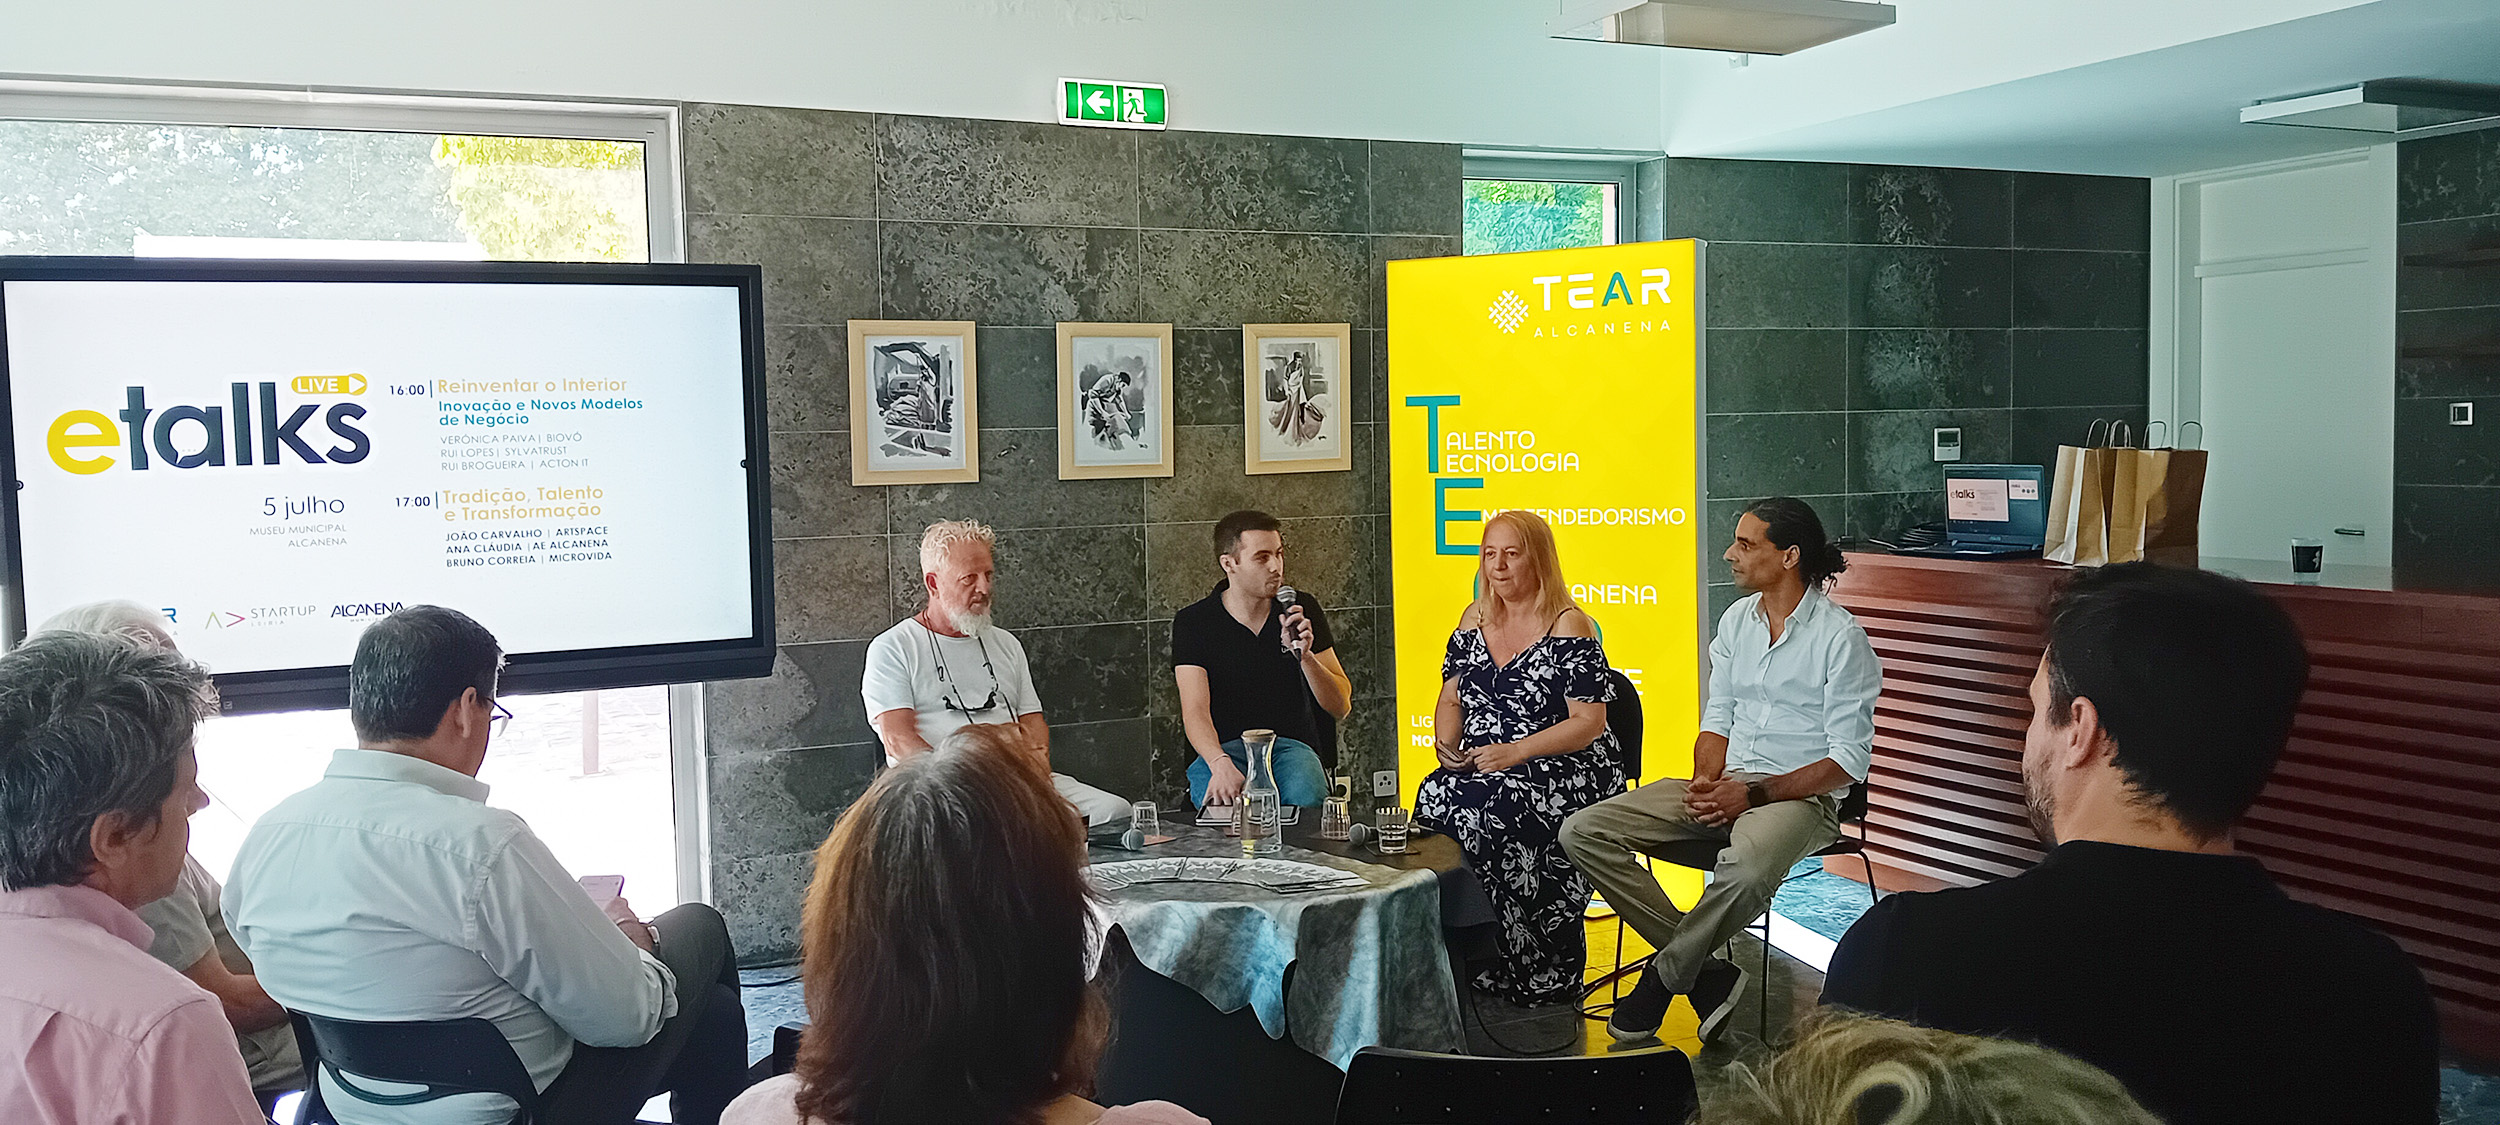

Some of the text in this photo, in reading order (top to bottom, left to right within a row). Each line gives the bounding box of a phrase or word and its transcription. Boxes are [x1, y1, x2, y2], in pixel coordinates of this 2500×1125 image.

[1532, 267, 1671, 311] TEAR
[1533, 319, 1671, 338] ALCANENA
[296, 377, 340, 393] LIVE
[390, 384, 425, 395] 16:00
[438, 377, 627, 393] Reinventar o Interior
[439, 398, 643, 414] Inovação e Novos Modelos
[47, 381, 371, 475] etalks
[439, 413, 529, 428] de Negócio
[502, 434, 536, 443] PAIVA
[441, 446, 567, 458] RUI LOPES SYLVATRUST
[441, 458, 589, 471] RUI BROGUEIRA ACTON IT
[395, 496, 430, 507] 17:00
[443, 485, 603, 506] Tradição, Talento
[263, 494, 345, 520] 5 julho
[444, 502, 601, 522] e Transformação
[250, 523, 347, 536] MUSEU MUNICIPAL
[445, 526, 608, 541] JOÃO CARVALHO ARTSPACE
[288, 537, 347, 548] ALCANENA
[446, 539, 608, 554] ANA CLÁUDIA AE ALCANENA
[446, 552, 612, 567] BRUNO CORREIA MICROVIDA
[250, 605, 316, 619] STARTUP
